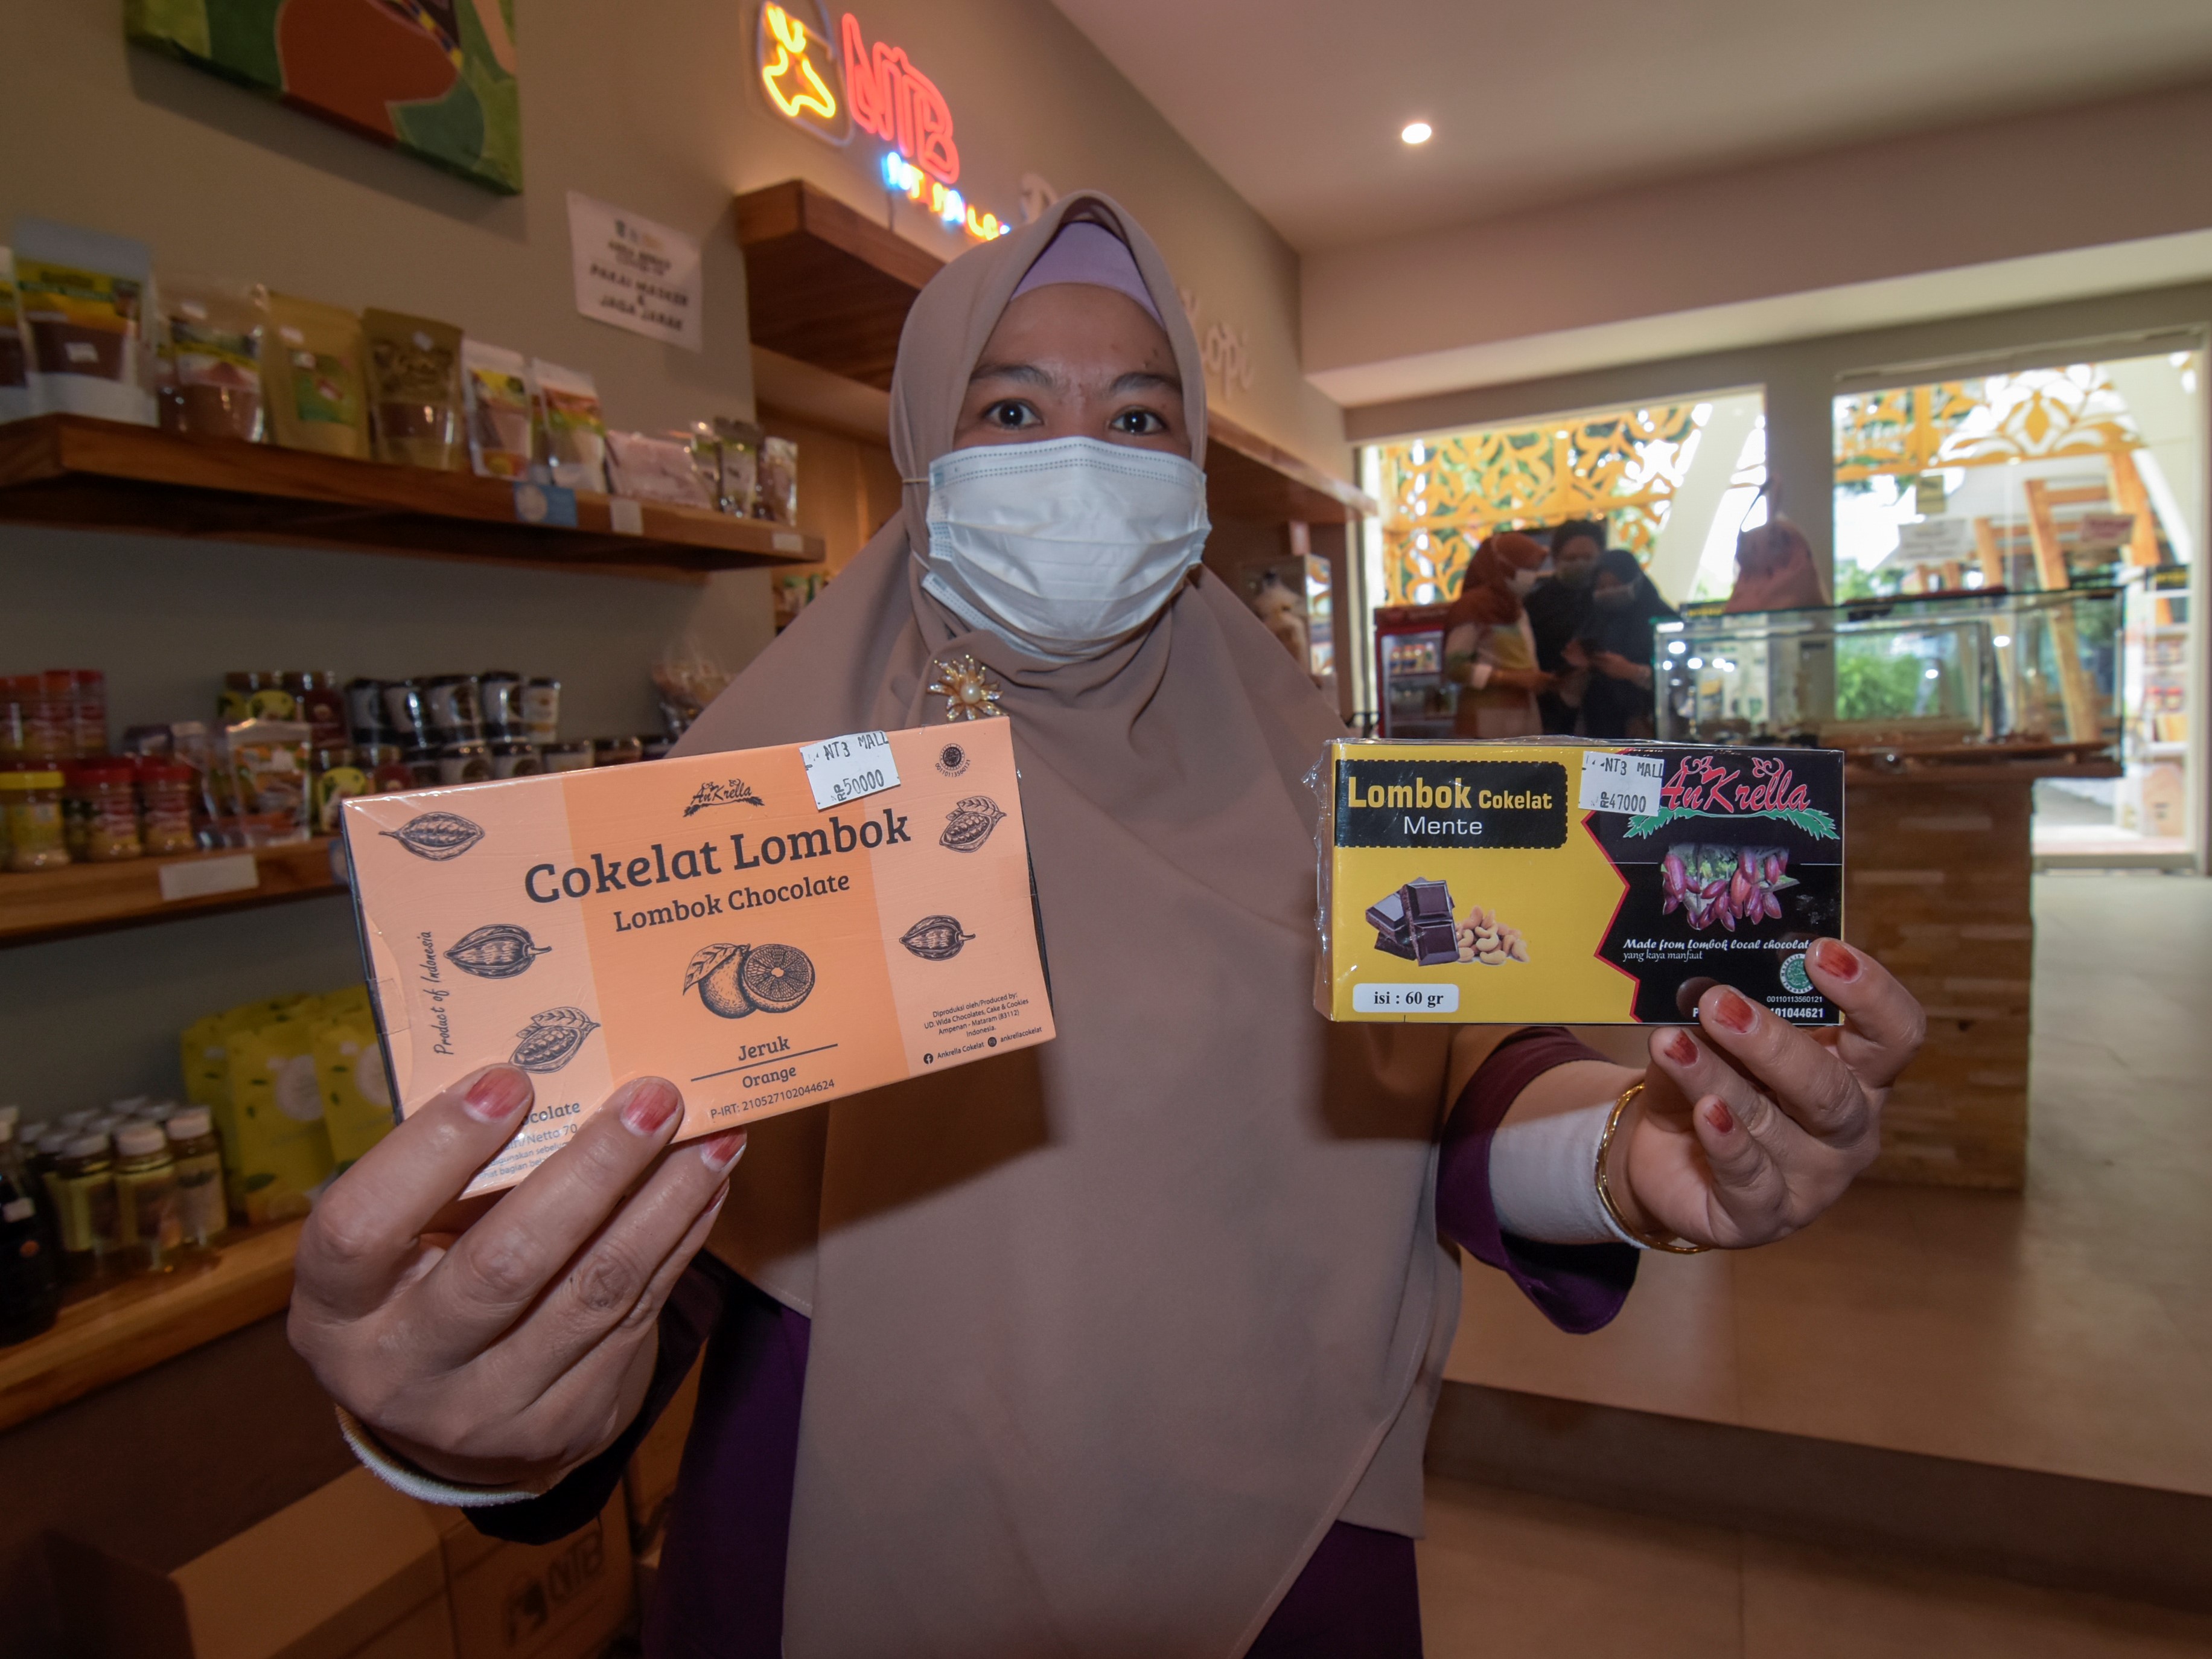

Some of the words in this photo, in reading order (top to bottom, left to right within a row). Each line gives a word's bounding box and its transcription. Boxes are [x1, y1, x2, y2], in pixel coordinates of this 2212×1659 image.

[857, 731, 889, 749] MALL
[1636, 762, 1663, 778] MALL
[1348, 776, 1472, 809] Lombok
[1479, 790, 1552, 810] Cokelat
[1404, 816, 1483, 835] Mente
[524, 842, 722, 904] Cokelat
[730, 808, 911, 871] Lombok
[613, 894, 723, 933] Lombok
[728, 873, 850, 911] Chocolate
[1622, 938, 1657, 950] Made
[1659, 939, 1685, 951] from
[1731, 939, 1761, 950] local
[1763, 939, 1812, 950] chocolat
[416, 932, 441, 983] Indonesia
[1622, 952, 1645, 962] yang
[1646, 949, 1666, 962] kaya
[1668, 949, 1704, 963] manfaat
[422, 988, 450, 1003] of
[932, 1005, 965, 1018] Diproduksi
[966, 994, 1008, 1009] oleh/Produced
[1374, 991, 1391, 1005] isi
[1405, 991, 1423, 1005] 60
[1427, 993, 1444, 1009] gr
[924, 1021, 935, 1029] UD.
[937, 1018, 951, 1027] Wida
[952, 1010, 986, 1022] Chocolates,
[1007, 999, 1028, 1009] Cookies
[939, 1023, 967, 1035] Ampenan
[972, 1017, 998, 1027] Mataram
[998, 1009, 1019, 1021] (83112)
[430, 1006, 454, 1055] Product
[1001, 1027, 1042, 1043] ankrellacokelat
[738, 1035, 791, 1061] Jeruk
[937, 1048, 961, 1059] Ankrella
[963, 1042, 984, 1052] Cokelat
[742, 1067, 797, 1088] Orange
[710, 1103, 741, 1119] P-IRT:
[742, 1079, 835, 1111] 210527102044624
[523, 1103, 580, 1125] colate
[564, 1124, 578, 1135] 70
[500, 1163, 528, 1176] bagian
